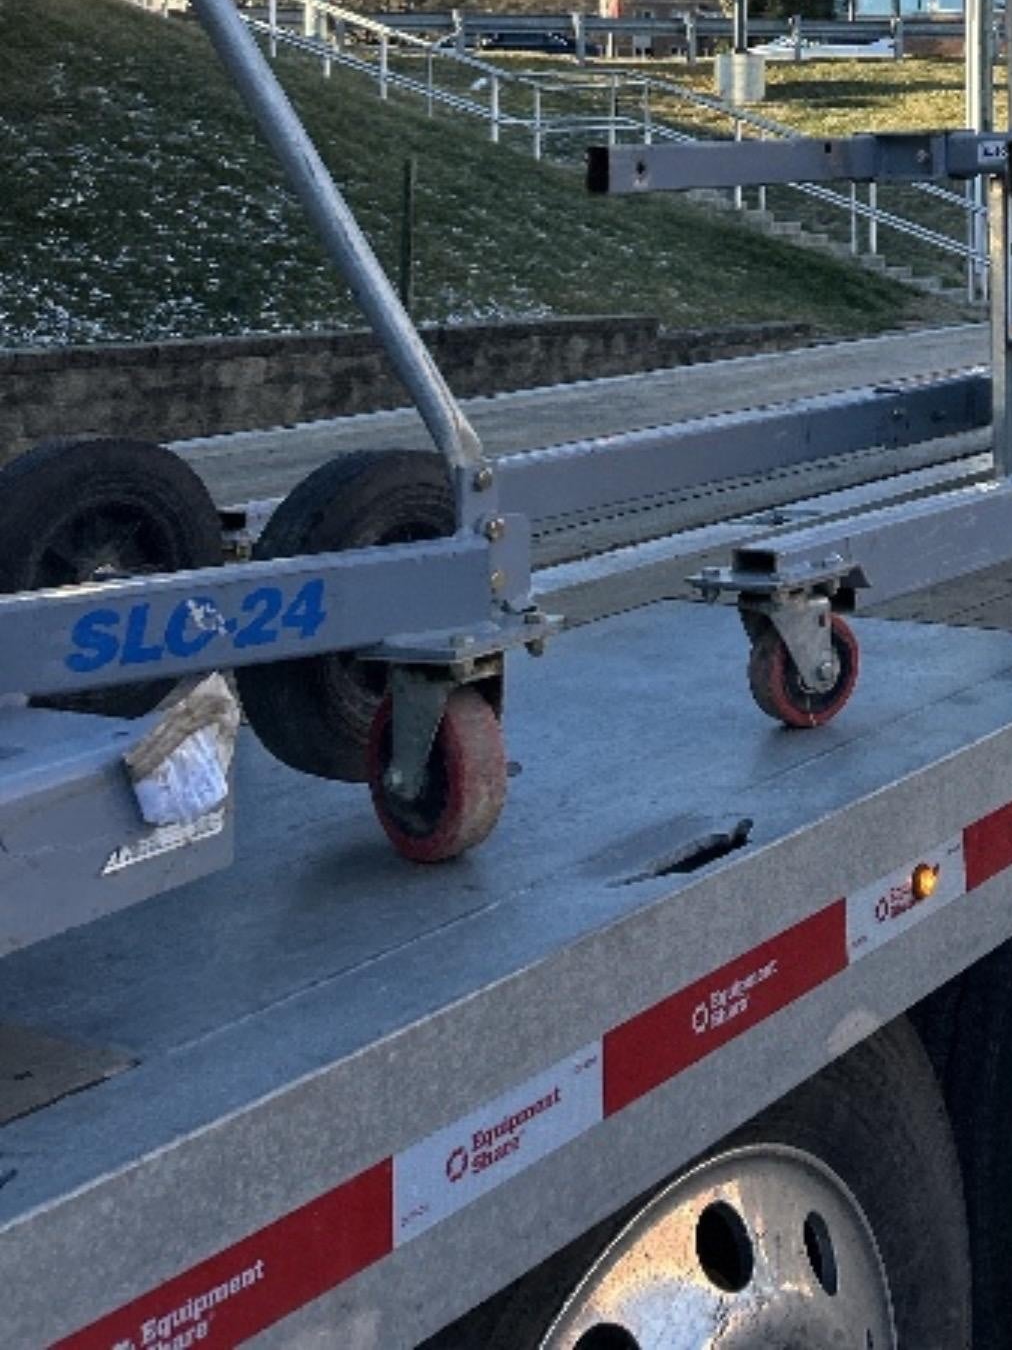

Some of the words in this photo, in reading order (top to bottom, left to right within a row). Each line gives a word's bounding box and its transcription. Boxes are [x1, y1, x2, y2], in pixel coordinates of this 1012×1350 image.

[65, 578, 328, 673] SLC-24
[471, 1085, 563, 1151] Equipment
[140, 1258, 266, 1347] Equipment
